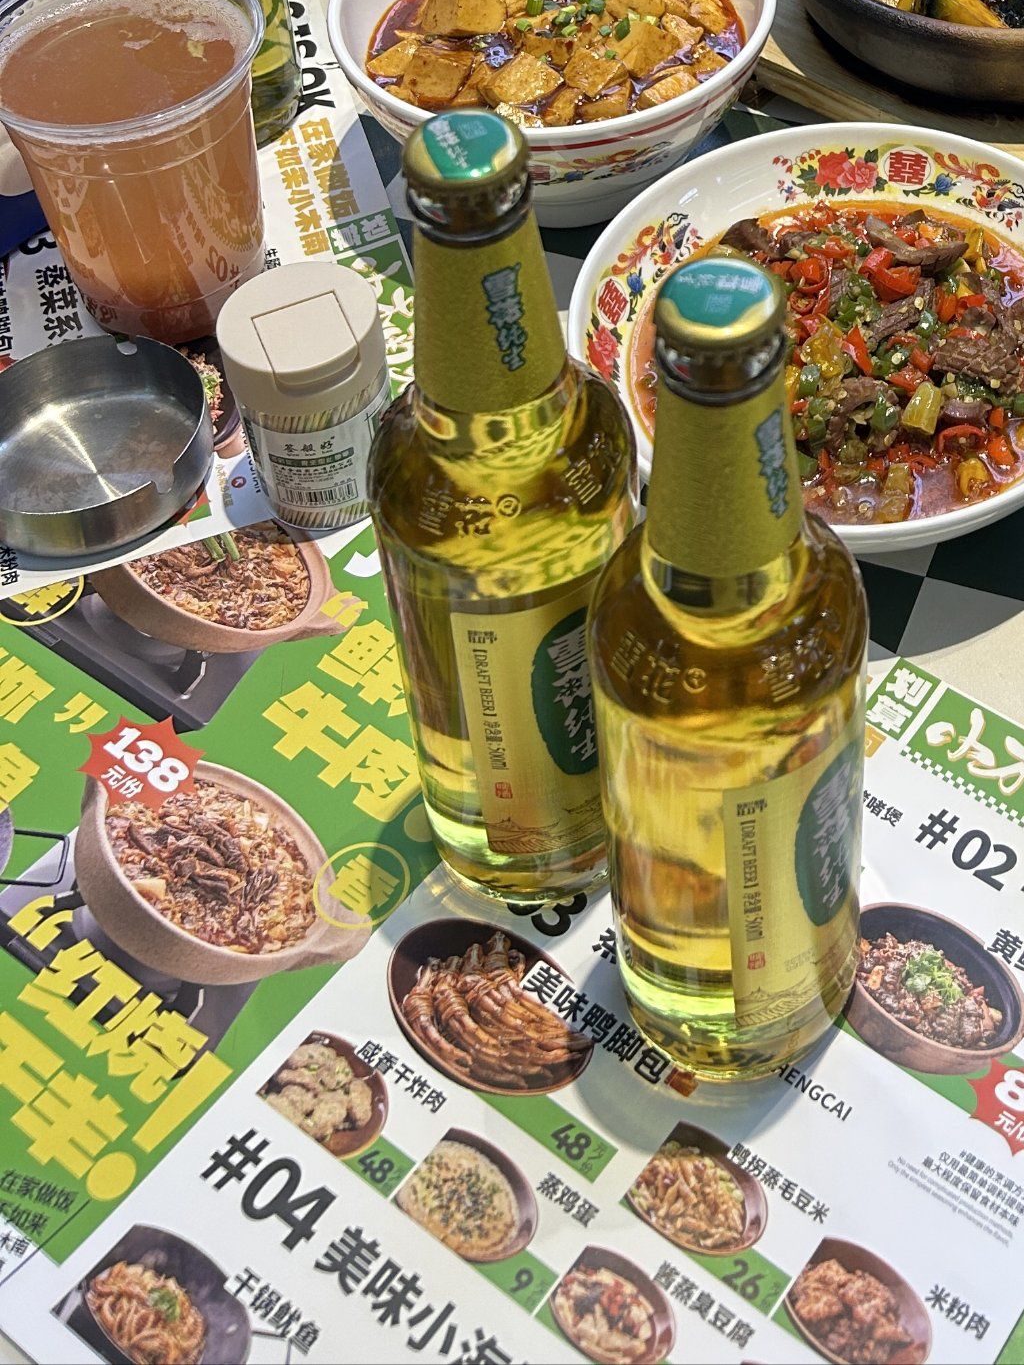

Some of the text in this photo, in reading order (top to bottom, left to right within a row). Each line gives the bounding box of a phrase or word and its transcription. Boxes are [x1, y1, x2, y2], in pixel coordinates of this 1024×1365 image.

[275, 128, 331, 256] 不如来小木南
[330, 214, 390, 253] 划算
[35, 265, 83, 347] 蒸菜系
[865, 666, 933, 734] 划算
[101, 764, 145, 798] 元/份
[103, 726, 190, 793] 138
[262, 681, 423, 823] 牛肉
[913, 806, 1019, 893] #02
[521, 965, 671, 1086] 美味鸭脚包
[356, 1039, 450, 1115] 咸香干炸肉
[356, 1148, 397, 1184] 48
[550, 1122, 593, 1162] 48
[200, 1126, 338, 1253] #04
[536, 1171, 602, 1229] 蒸鸡蛋
[730, 1142, 832, 1226] 鸭拐蒸毛豆米
[511, 1268, 535, 1293] 9
[722, 1257, 762, 1301] 26
[925, 1284, 991, 1342] 米粉肉
